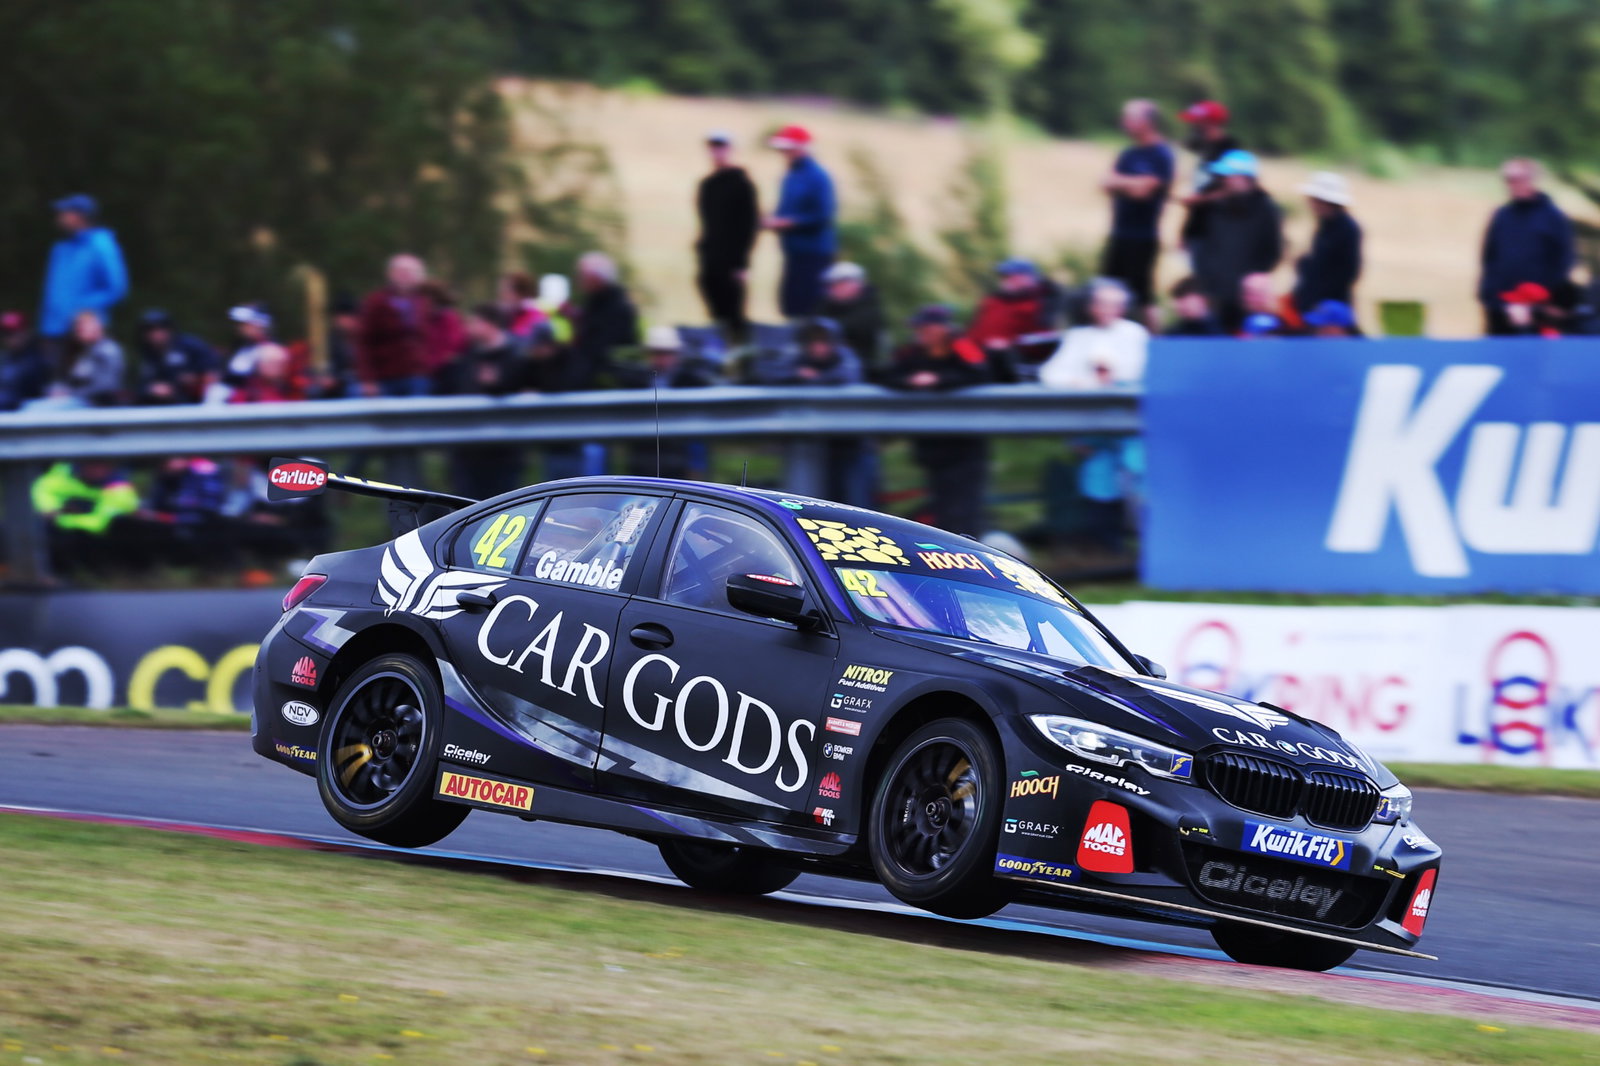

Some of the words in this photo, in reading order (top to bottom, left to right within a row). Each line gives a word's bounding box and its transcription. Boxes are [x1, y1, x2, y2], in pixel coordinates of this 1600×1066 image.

[271, 468, 325, 486] Carlube
[474, 514, 526, 568] 42
[535, 551, 624, 590] Gamble
[917, 552, 997, 578] HOOCH
[841, 569, 888, 598] 42
[291, 656, 317, 679] MAC
[842, 665, 894, 685] NITROX
[291, 675, 316, 686] TOOLS
[838, 678, 855, 687] Fuel
[854, 681, 886, 693] Additives
[478, 594, 610, 709] CAR
[623, 653, 816, 792] GODS
[843, 696, 872, 709] GRAFX
[289, 704, 311, 718] NCV
[444, 743, 492, 765] Ciceley
[1212, 727, 1280, 751] CAR
[1297, 742, 1367, 773] GODS
[445, 775, 528, 808] AUTOCAR
[819, 772, 842, 792] MAC
[1010, 775, 1060, 800] HOOCH
[818, 789, 840, 800] TOOLS
[1018, 820, 1059, 834] GRAFX
[1084, 823, 1126, 848] MAC
[1083, 840, 1125, 856] TOOLS
[998, 858, 1072, 877] GOODYEAR
[1199, 861, 1344, 919] Ciceley
[1413, 888, 1431, 909] MA
